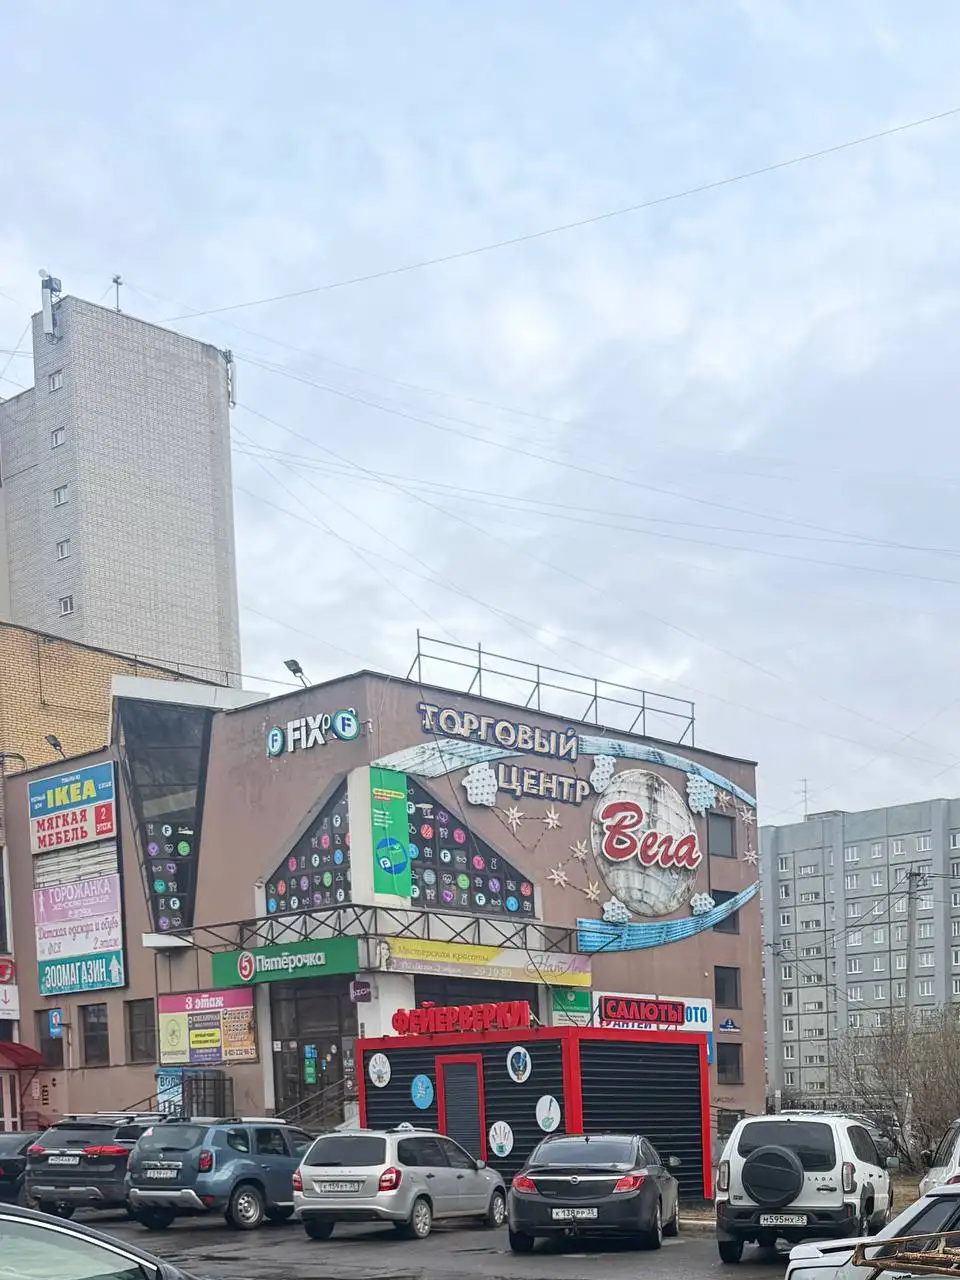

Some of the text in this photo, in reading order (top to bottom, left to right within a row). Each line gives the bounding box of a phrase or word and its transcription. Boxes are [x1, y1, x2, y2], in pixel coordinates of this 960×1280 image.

[417, 702, 579, 761] ТОРГОВЫЙ
[46, 779, 96, 808] IKEA
[498, 763, 591, 805] ЦЕНТР
[36, 809, 87, 833] МЯГКАЯ
[101, 807, 106, 820] 2
[37, 826, 88, 849] МЕБЕЛЬ
[600, 800, 702, 868] Вега
[49, 879, 111, 903] ГОРОЖАНКА
[45, 959, 107, 988] ЗООМАГАЗИН
[256, 951, 326, 973] Пятёрочка
[392, 1000, 529, 1035] ФЕЙЕРВЕРКИ
[605, 1000, 683, 1023] САЛЮТЫ
[685, 1006, 708, 1022] ОТО
[763, 1215, 794, 1226] М595МХ
